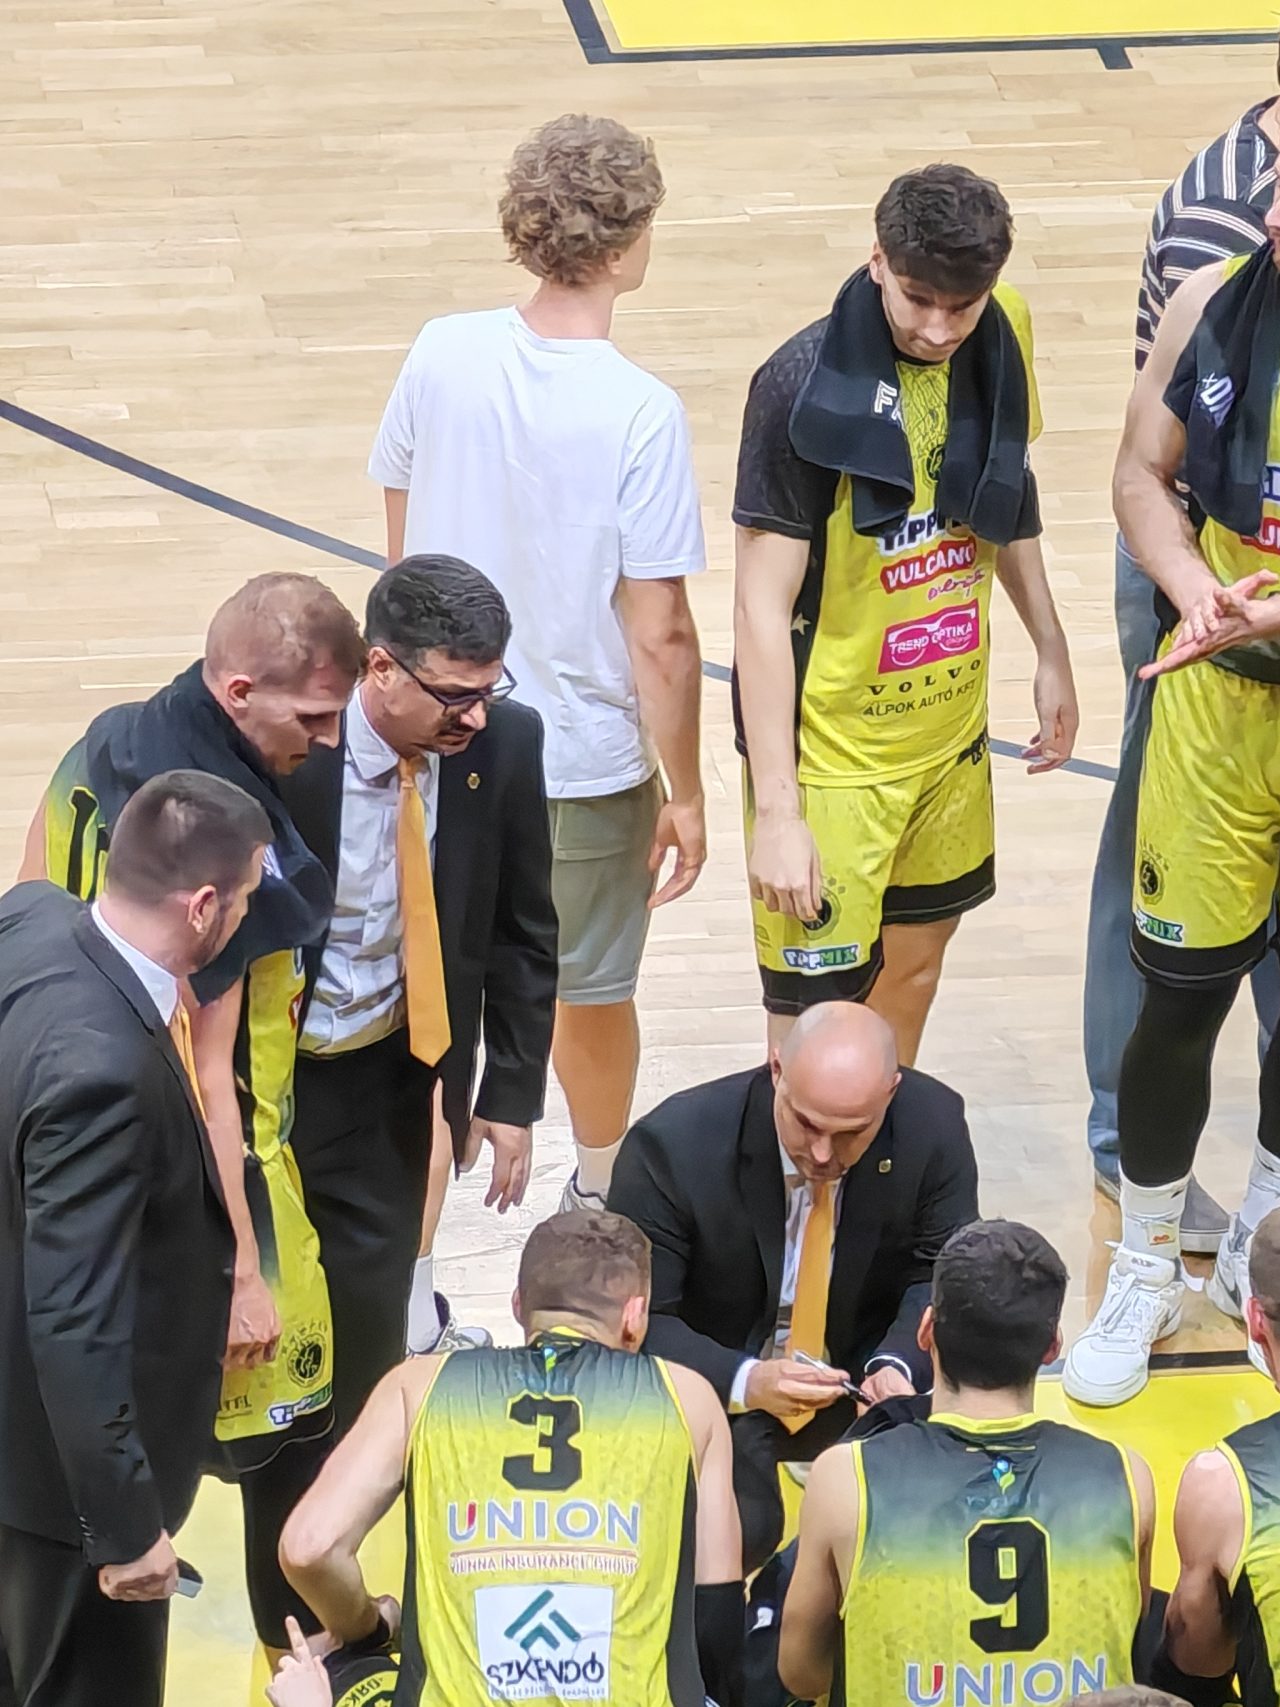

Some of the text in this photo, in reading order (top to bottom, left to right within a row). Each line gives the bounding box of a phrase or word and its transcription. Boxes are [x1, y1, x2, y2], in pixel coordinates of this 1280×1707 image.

[889, 636, 929, 655] TREND
[931, 622, 973, 644] OPTIKA
[865, 659, 981, 696] VOLVO
[501, 1394, 583, 1491] 3
[449, 1500, 640, 1544] UNION
[966, 1519, 1050, 1654] 9
[906, 1656, 1106, 1707] UNION
